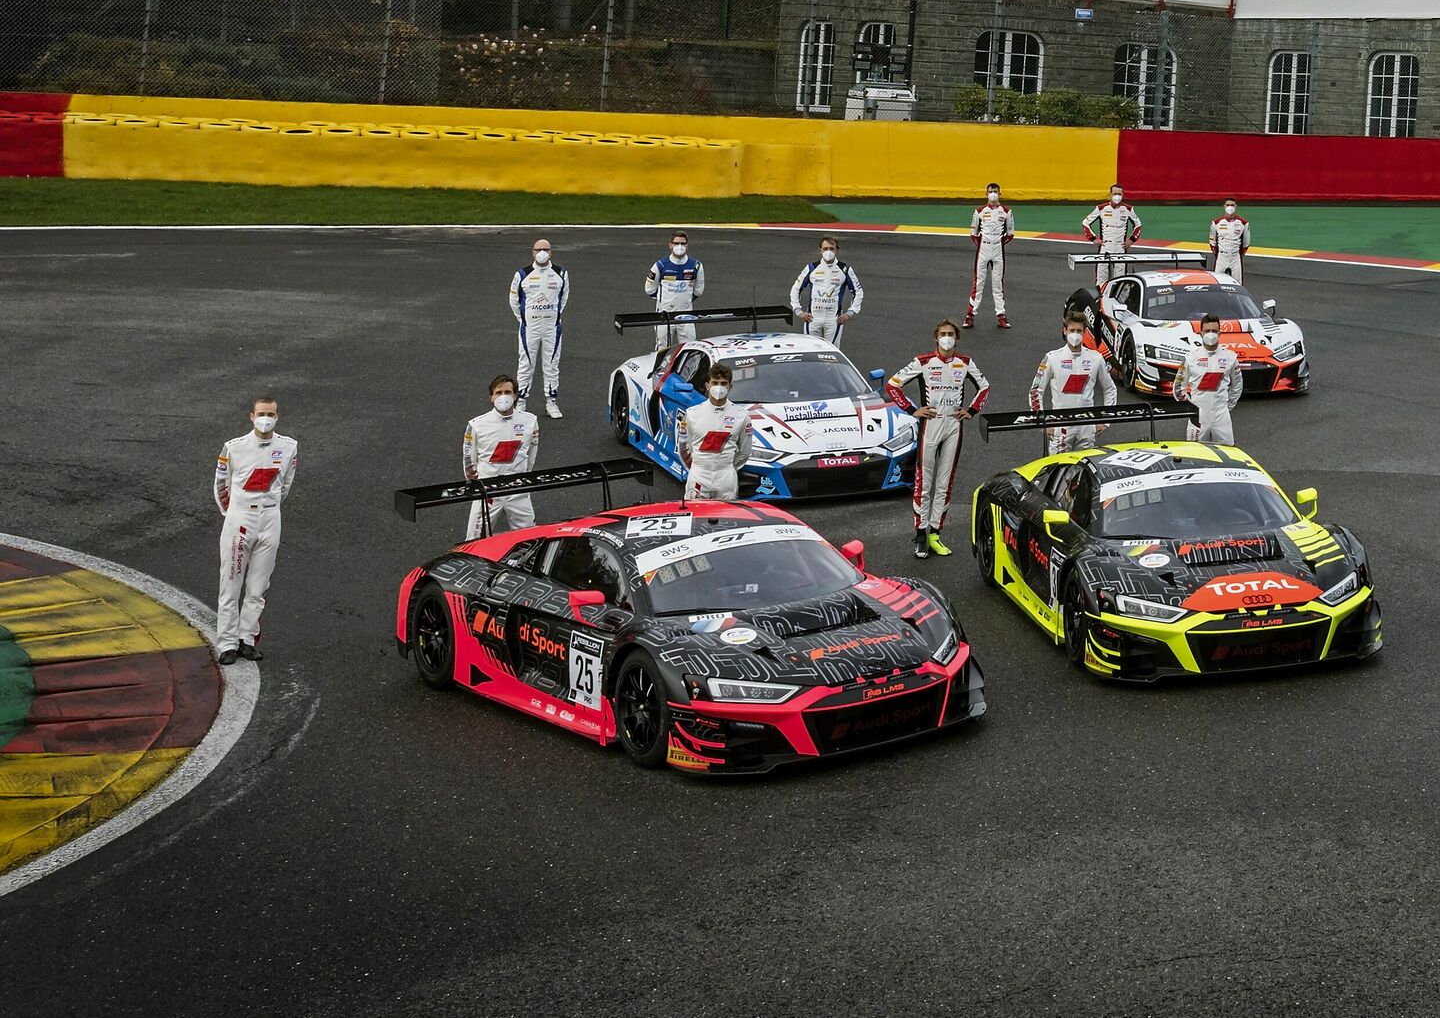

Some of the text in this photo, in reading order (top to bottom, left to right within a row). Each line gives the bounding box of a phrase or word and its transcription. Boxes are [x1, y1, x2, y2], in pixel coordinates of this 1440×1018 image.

[940, 398, 959, 407] fitbit
[784, 405, 811, 414] Power
[821, 457, 857, 466] TOTAL
[1117, 450, 1152, 463] 30
[1224, 470, 1248, 478] aws
[1117, 479, 1142, 490] aws
[640, 517, 678, 532] 25
[774, 527, 801, 535] aws
[1194, 538, 1265, 550] Audi Sport
[659, 543, 690, 558] aws
[1206, 578, 1299, 596] TOTAL
[696, 613, 725, 621] PRO
[532, 630, 566, 661] Sport
[828, 634, 902, 653] Audi Sport
[1231, 639, 1312, 657] Audi Sport
[575, 655, 594, 694] 25
[883, 684, 905, 695] LMS
[854, 701, 933, 732] Audi Sport
